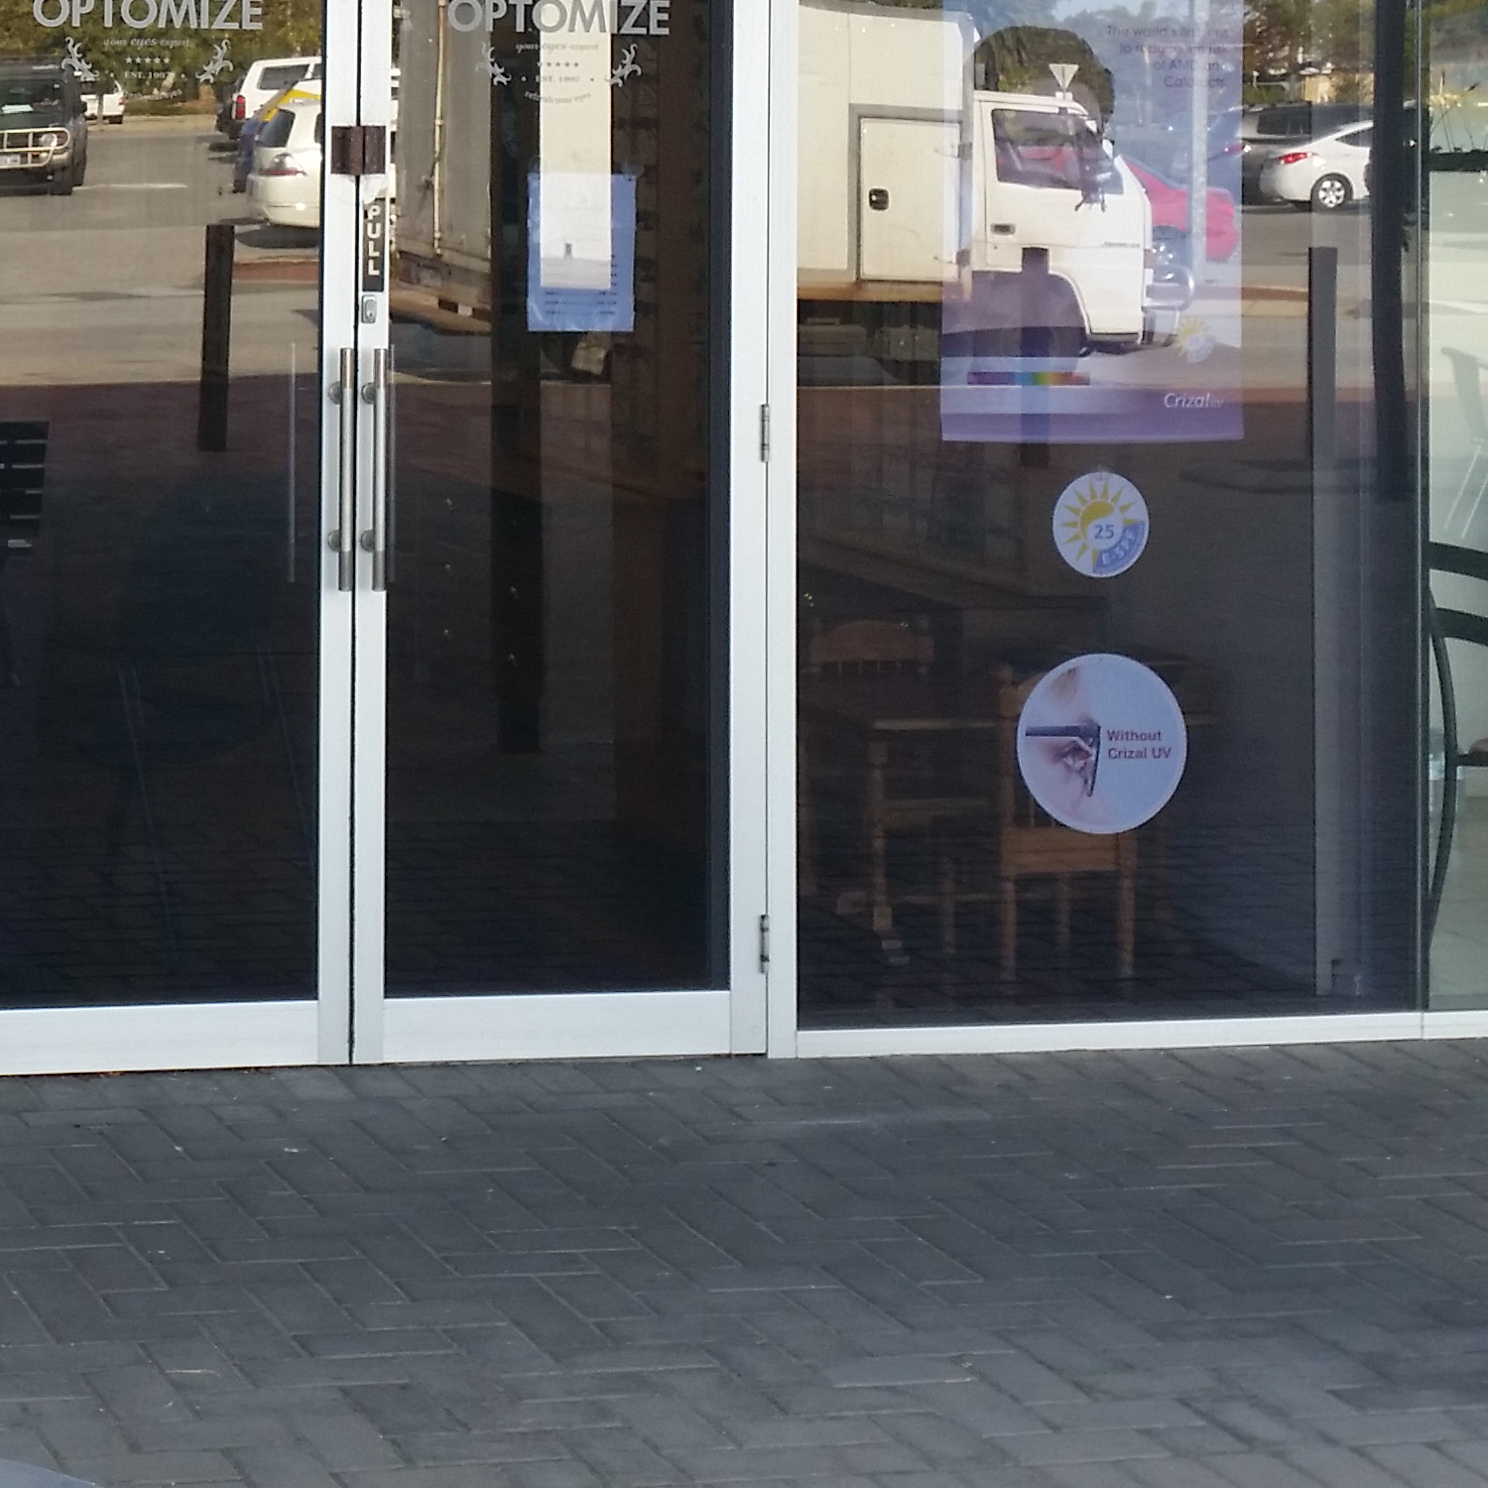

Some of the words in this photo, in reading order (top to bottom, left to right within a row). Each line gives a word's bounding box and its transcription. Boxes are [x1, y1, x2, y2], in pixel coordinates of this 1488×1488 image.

[366, 205, 381, 276] PULL
[1163, 392, 1211, 409] Crizal
[1094, 524, 1115, 539] 25
[1101, 529, 1135, 565] E-SPF
[1106, 730, 1162, 741] Without
[1108, 747, 1147, 760] Crizal
[1152, 747, 1172, 759] UV
